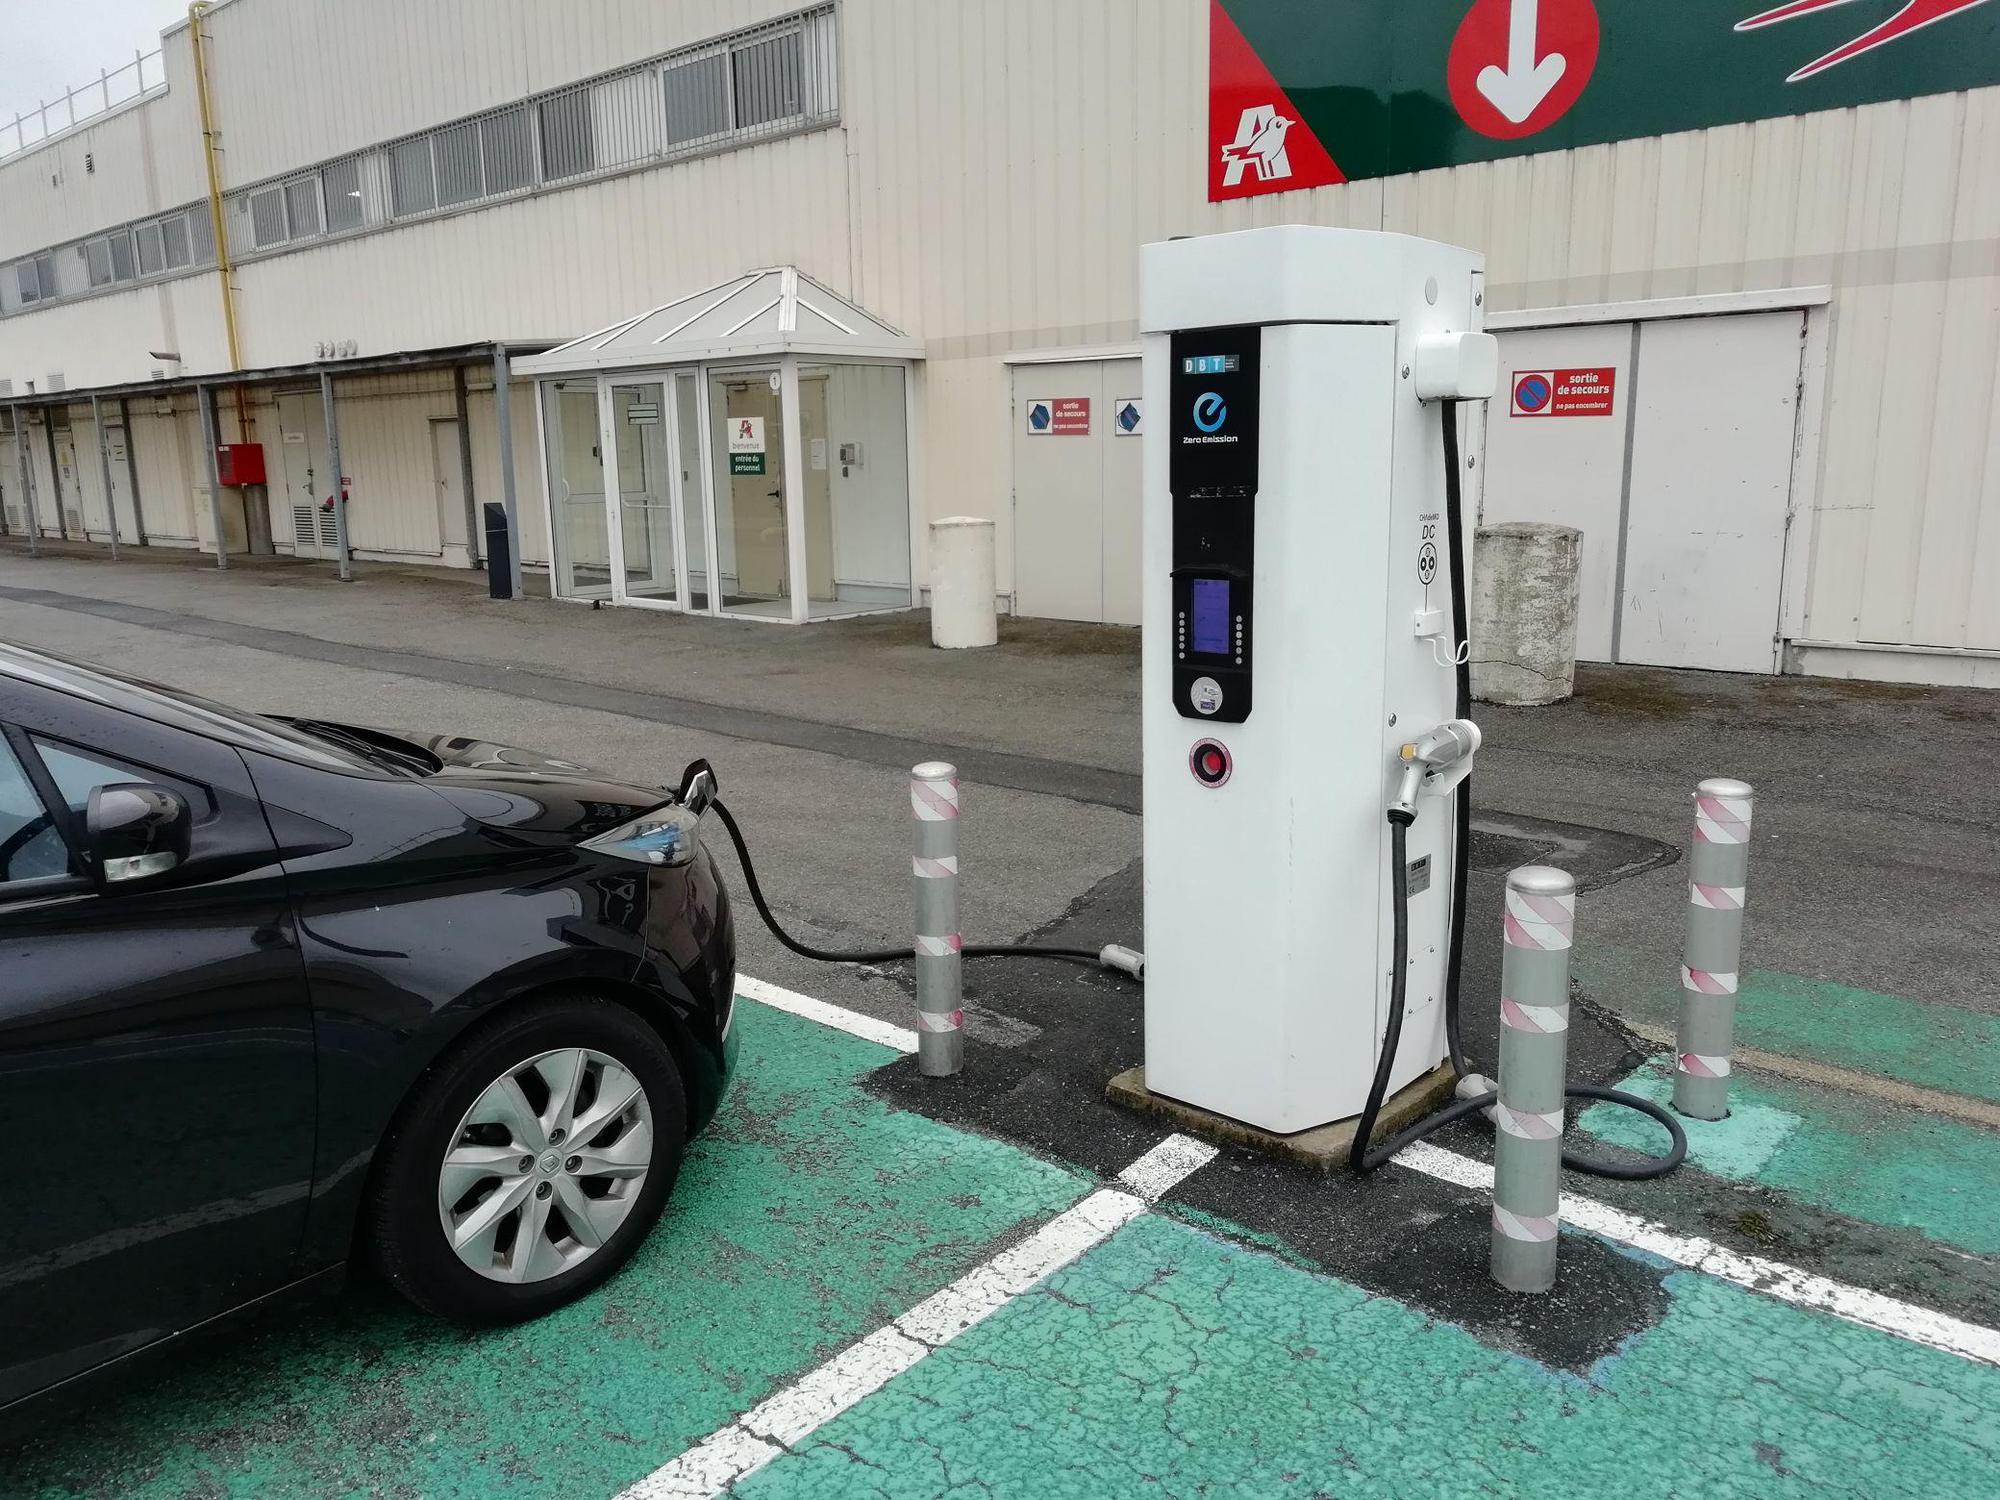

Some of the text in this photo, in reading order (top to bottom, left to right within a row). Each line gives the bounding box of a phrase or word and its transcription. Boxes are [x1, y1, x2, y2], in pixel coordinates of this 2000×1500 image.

[1185, 358, 1221, 373] DBT
[1569, 373, 1599, 384] sortie
[1557, 385, 1610, 395] de secours
[1062, 402, 1080, 410] sortie
[1183, 435, 1239, 444] Zero Emission
[732, 442, 760, 450] bienvenue
[735, 455, 760, 463] entrée du
[735, 464, 760, 473] personnel
[1422, 524, 1436, 540] DC
